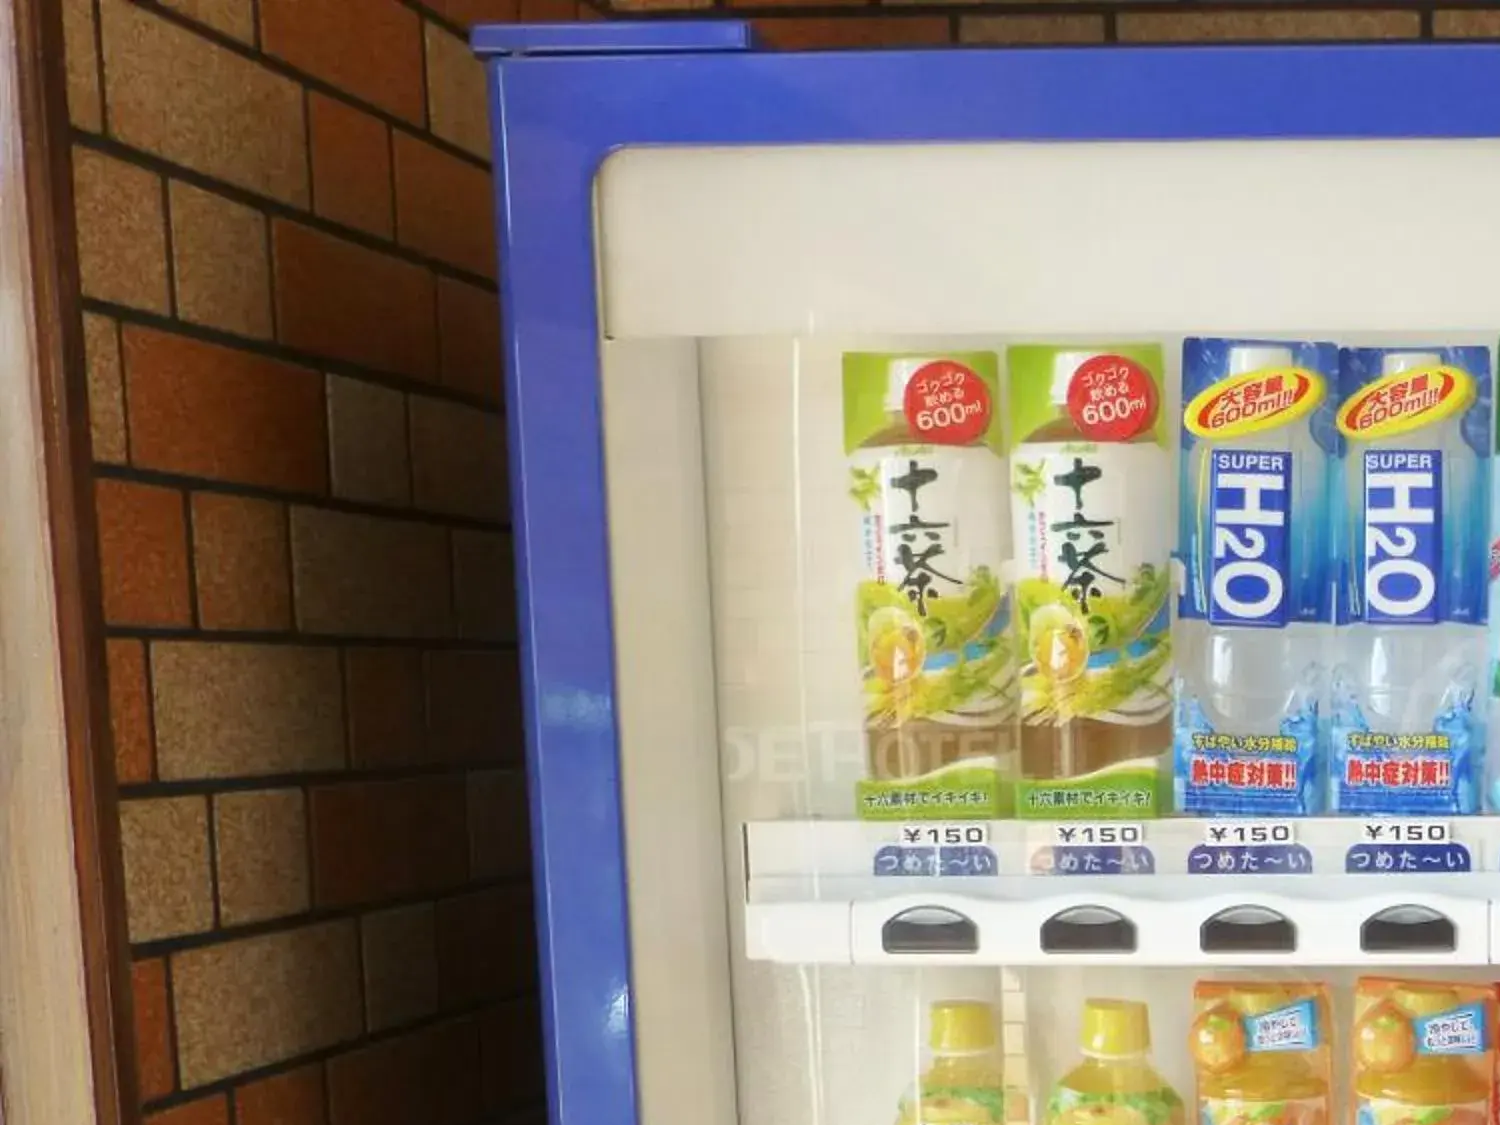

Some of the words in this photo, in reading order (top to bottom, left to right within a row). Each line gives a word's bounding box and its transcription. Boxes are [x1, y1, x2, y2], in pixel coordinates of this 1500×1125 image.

[915, 372, 965, 395] ゴクゴク
[1081, 367, 1130, 389] ゴクゴク
[924, 387, 965, 408] 飲める
[1089, 381, 1130, 403] 飲める
[1219, 374, 1285, 411] 大容量
[1368, 374, 1430, 411] 大容量
[915, 399, 982, 431] 600ml
[1081, 394, 1147, 426] 600ml
[1217, 454, 1284, 471] SUPER
[1367, 453, 1432, 470] SUPER
[888, 459, 964, 617] 十六茶
[1051, 457, 1127, 616] 十六茶
[1212, 472, 1285, 619] H2O
[1365, 471, 1436, 619] H2O
[903, 826, 984, 844] ¥150
[1058, 826, 1138, 843] ¥150
[1209, 825, 1290, 842] ¥150
[1365, 825, 1446, 842] ¥150
